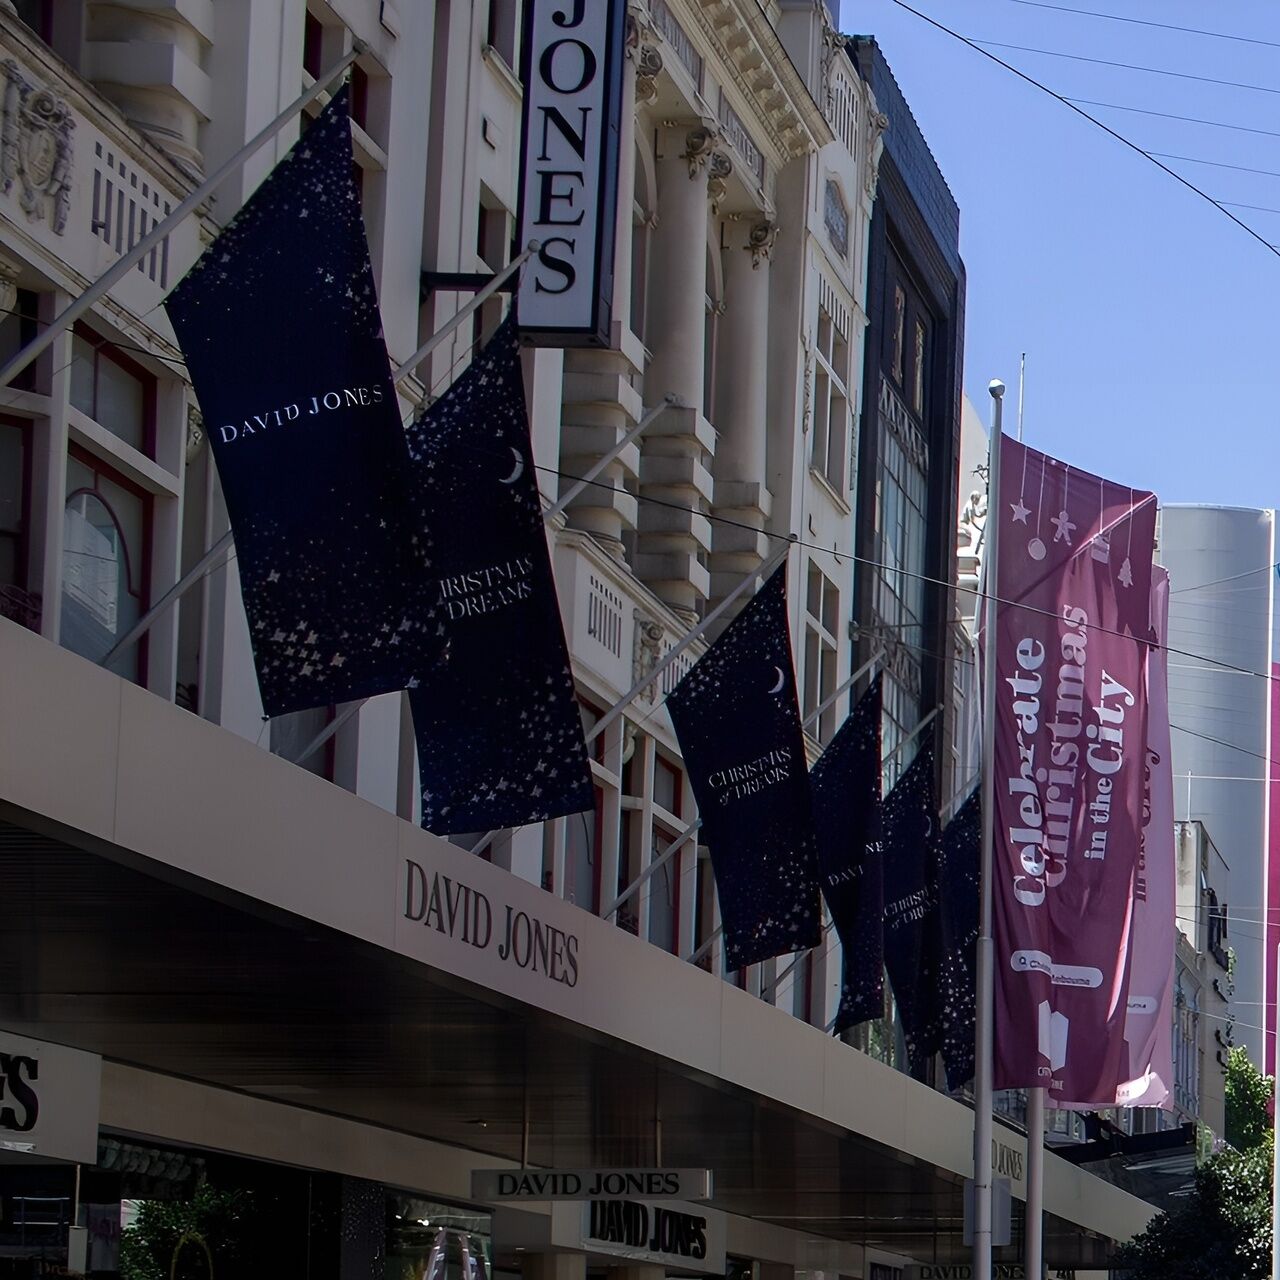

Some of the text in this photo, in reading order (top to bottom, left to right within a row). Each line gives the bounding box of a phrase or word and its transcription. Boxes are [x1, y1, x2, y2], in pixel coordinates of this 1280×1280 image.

[220, 384, 383, 443] DAVID JONES
[1006, 637, 1046, 907] Celebrate
[1084, 669, 1135, 861] in the City
[404, 859, 579, 988] DAVID JONES
[498, 1172, 680, 1196] DAVID JONES
[649, 1207, 707, 1260] JONES
[920, 1265, 970, 1280] DAVID
